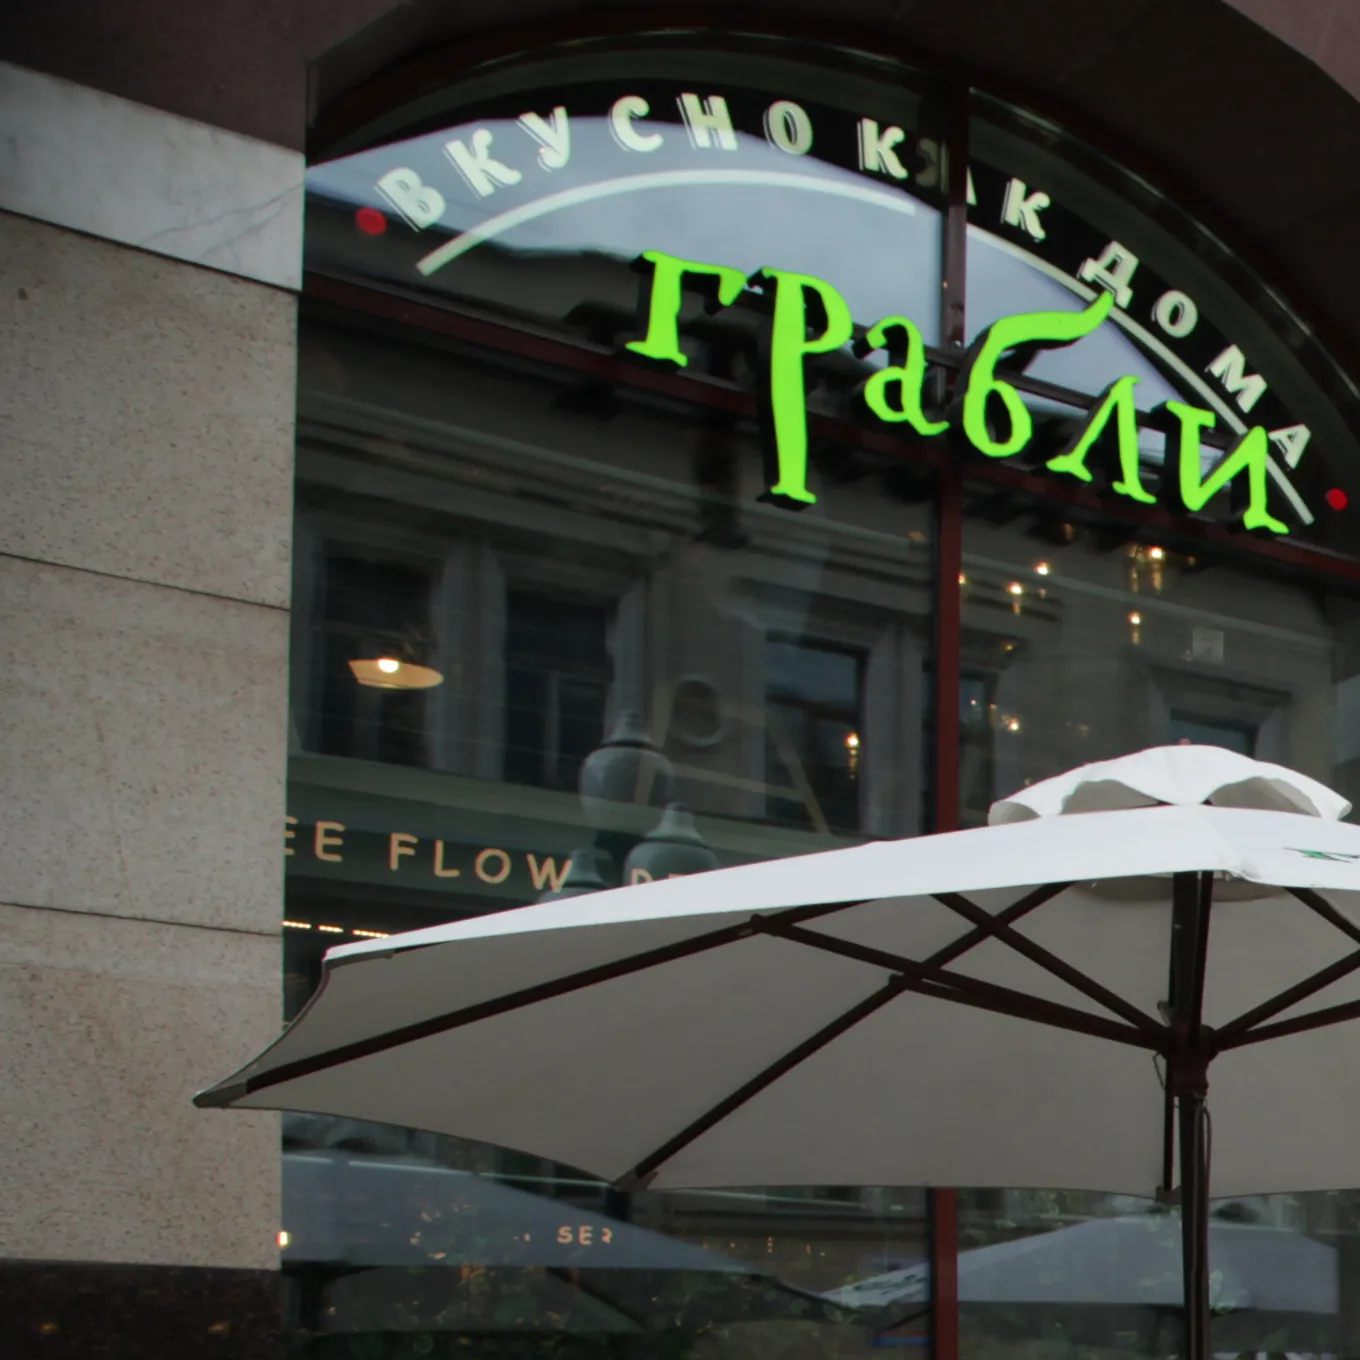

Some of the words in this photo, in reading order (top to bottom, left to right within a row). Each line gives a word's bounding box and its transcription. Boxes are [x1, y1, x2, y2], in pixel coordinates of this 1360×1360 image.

[376, 92, 814, 231] ВКУСНО
[856, 116, 1052, 243] КК
[389, 832, 573, 893] FLOW
